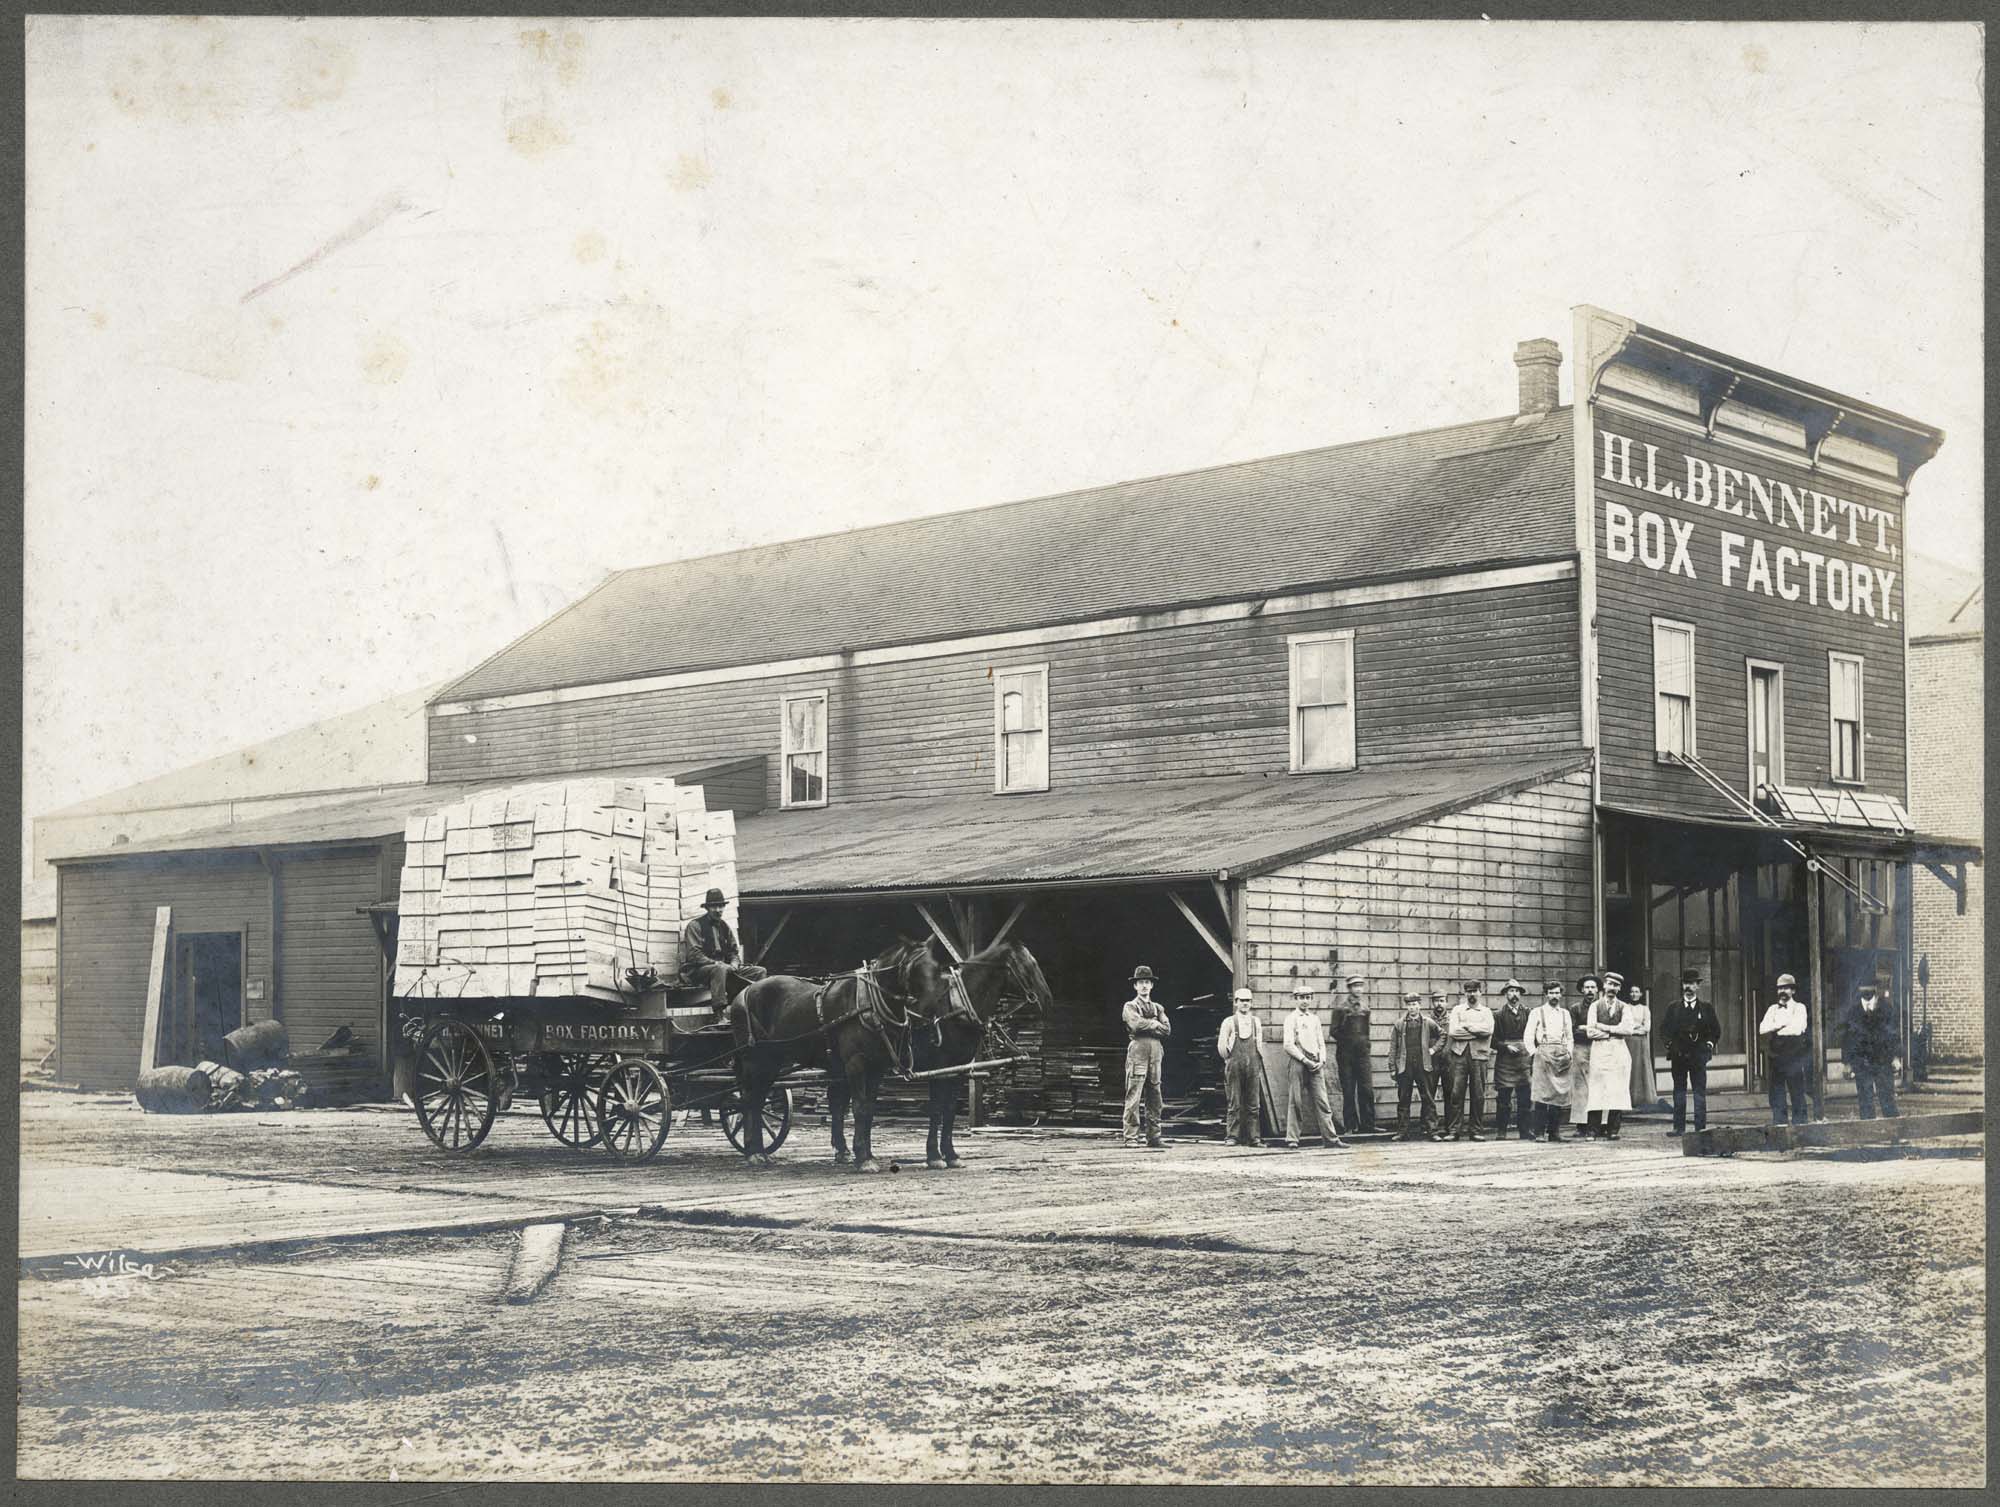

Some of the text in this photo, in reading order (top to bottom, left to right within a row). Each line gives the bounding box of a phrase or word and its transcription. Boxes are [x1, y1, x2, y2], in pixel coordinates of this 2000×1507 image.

[1605, 501, 1898, 622] BOX FACTORY.
[546, 1025, 574, 1039] BOX
